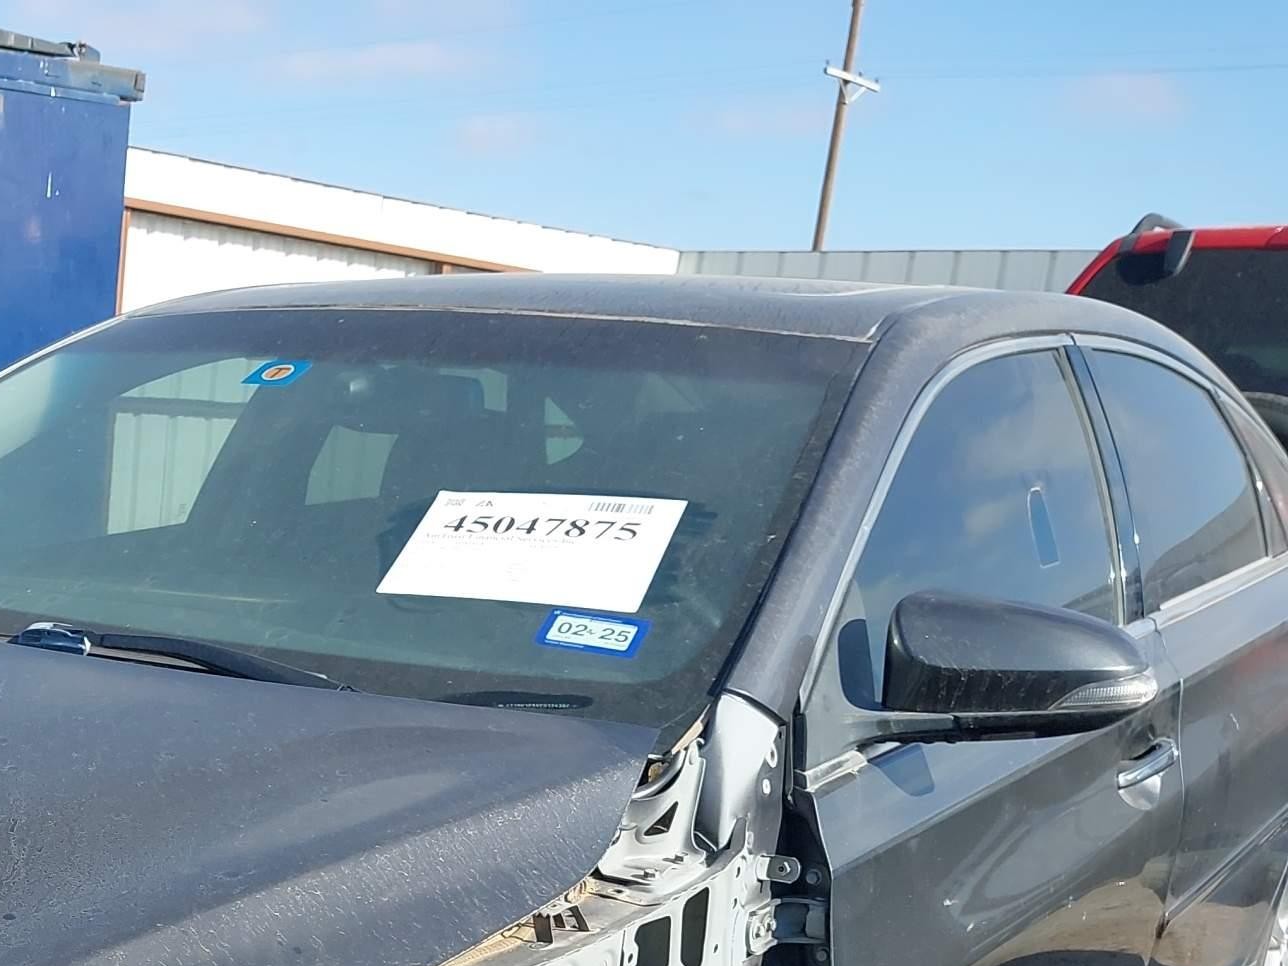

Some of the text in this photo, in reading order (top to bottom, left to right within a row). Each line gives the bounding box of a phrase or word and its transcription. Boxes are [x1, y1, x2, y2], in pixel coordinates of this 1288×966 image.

[444, 515, 643, 541] 45047875
[557, 621, 632, 643] 02 25
